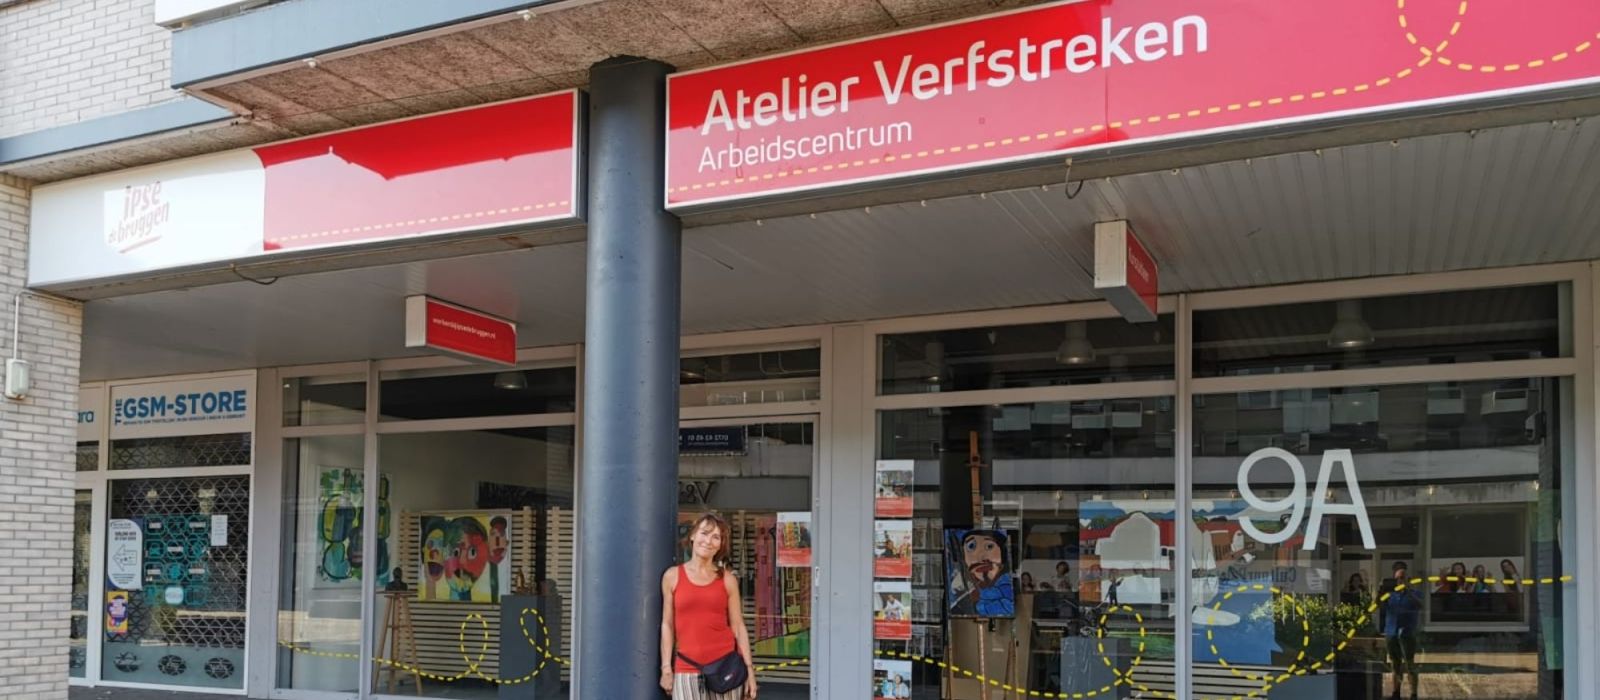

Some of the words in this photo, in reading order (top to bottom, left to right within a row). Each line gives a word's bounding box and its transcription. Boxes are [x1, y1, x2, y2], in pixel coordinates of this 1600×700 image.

[701, 74, 859, 136] Atelier
[873, 15, 1207, 105] Verfstreken
[698, 121, 912, 173] Arbeidscentrum
[117, 201, 170, 243] bruggen
[123, 390, 247, 418] GSM-STORE
[1237, 447, 1376, 550] 9A
